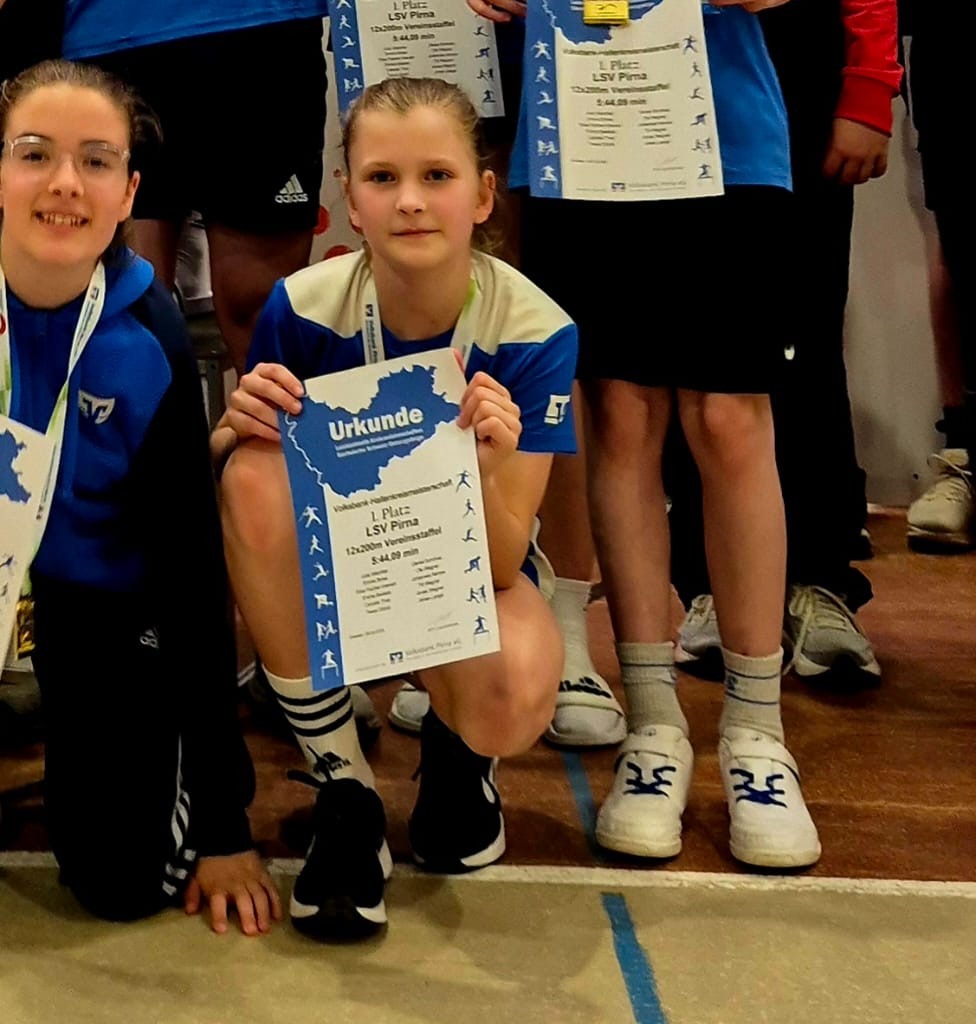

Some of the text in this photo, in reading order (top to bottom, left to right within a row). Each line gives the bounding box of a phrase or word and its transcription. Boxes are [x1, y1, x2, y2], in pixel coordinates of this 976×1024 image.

[388, 10, 435, 21] LSV Pirna
[592, 72, 648, 82] LSV Pirna
[328, 406, 424, 441] Urkunde
[382, 505, 411, 520] Platz
[366, 517, 419, 537] LSV Pirna
